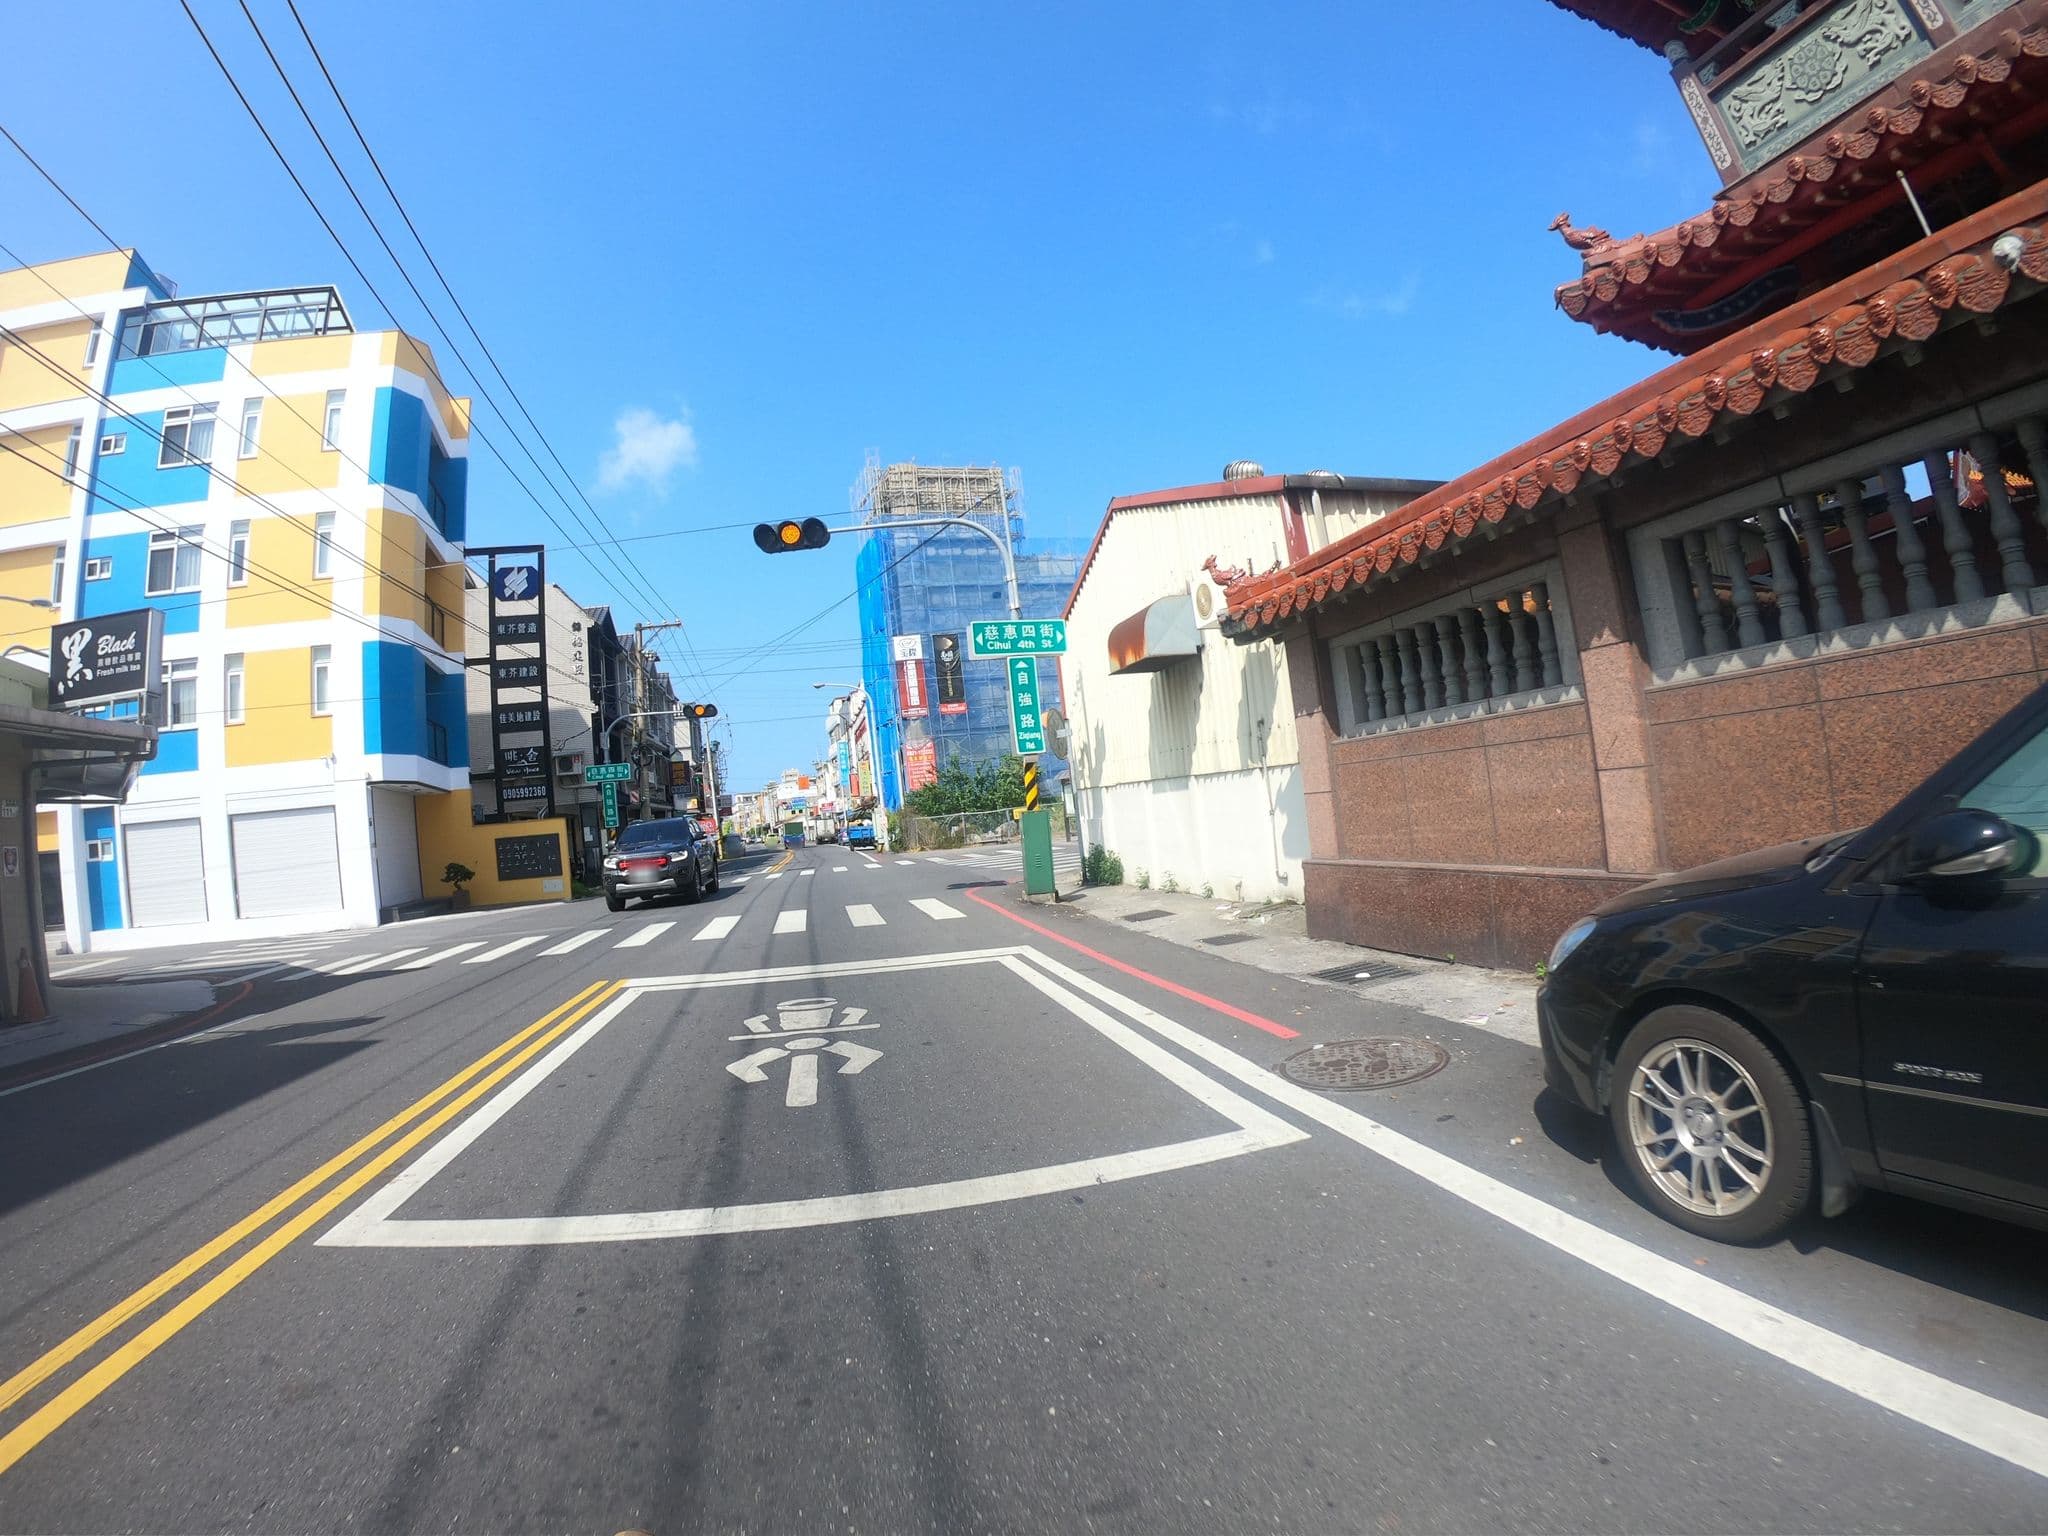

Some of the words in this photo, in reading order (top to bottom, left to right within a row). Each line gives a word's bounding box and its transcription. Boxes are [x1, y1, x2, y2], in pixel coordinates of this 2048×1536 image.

[984, 623, 1055, 640] 慈惠四街
[97, 631, 136, 655] Black
[987, 640, 1012, 650] Cihui
[1017, 639, 1036, 649] 4th
[96, 667, 115, 678] Fresh
[115, 664, 129, 674] milk
[130, 663, 141, 672] tea
[1017, 671, 1035, 728] 自強路
[502, 786, 546, 799] 0905992360
